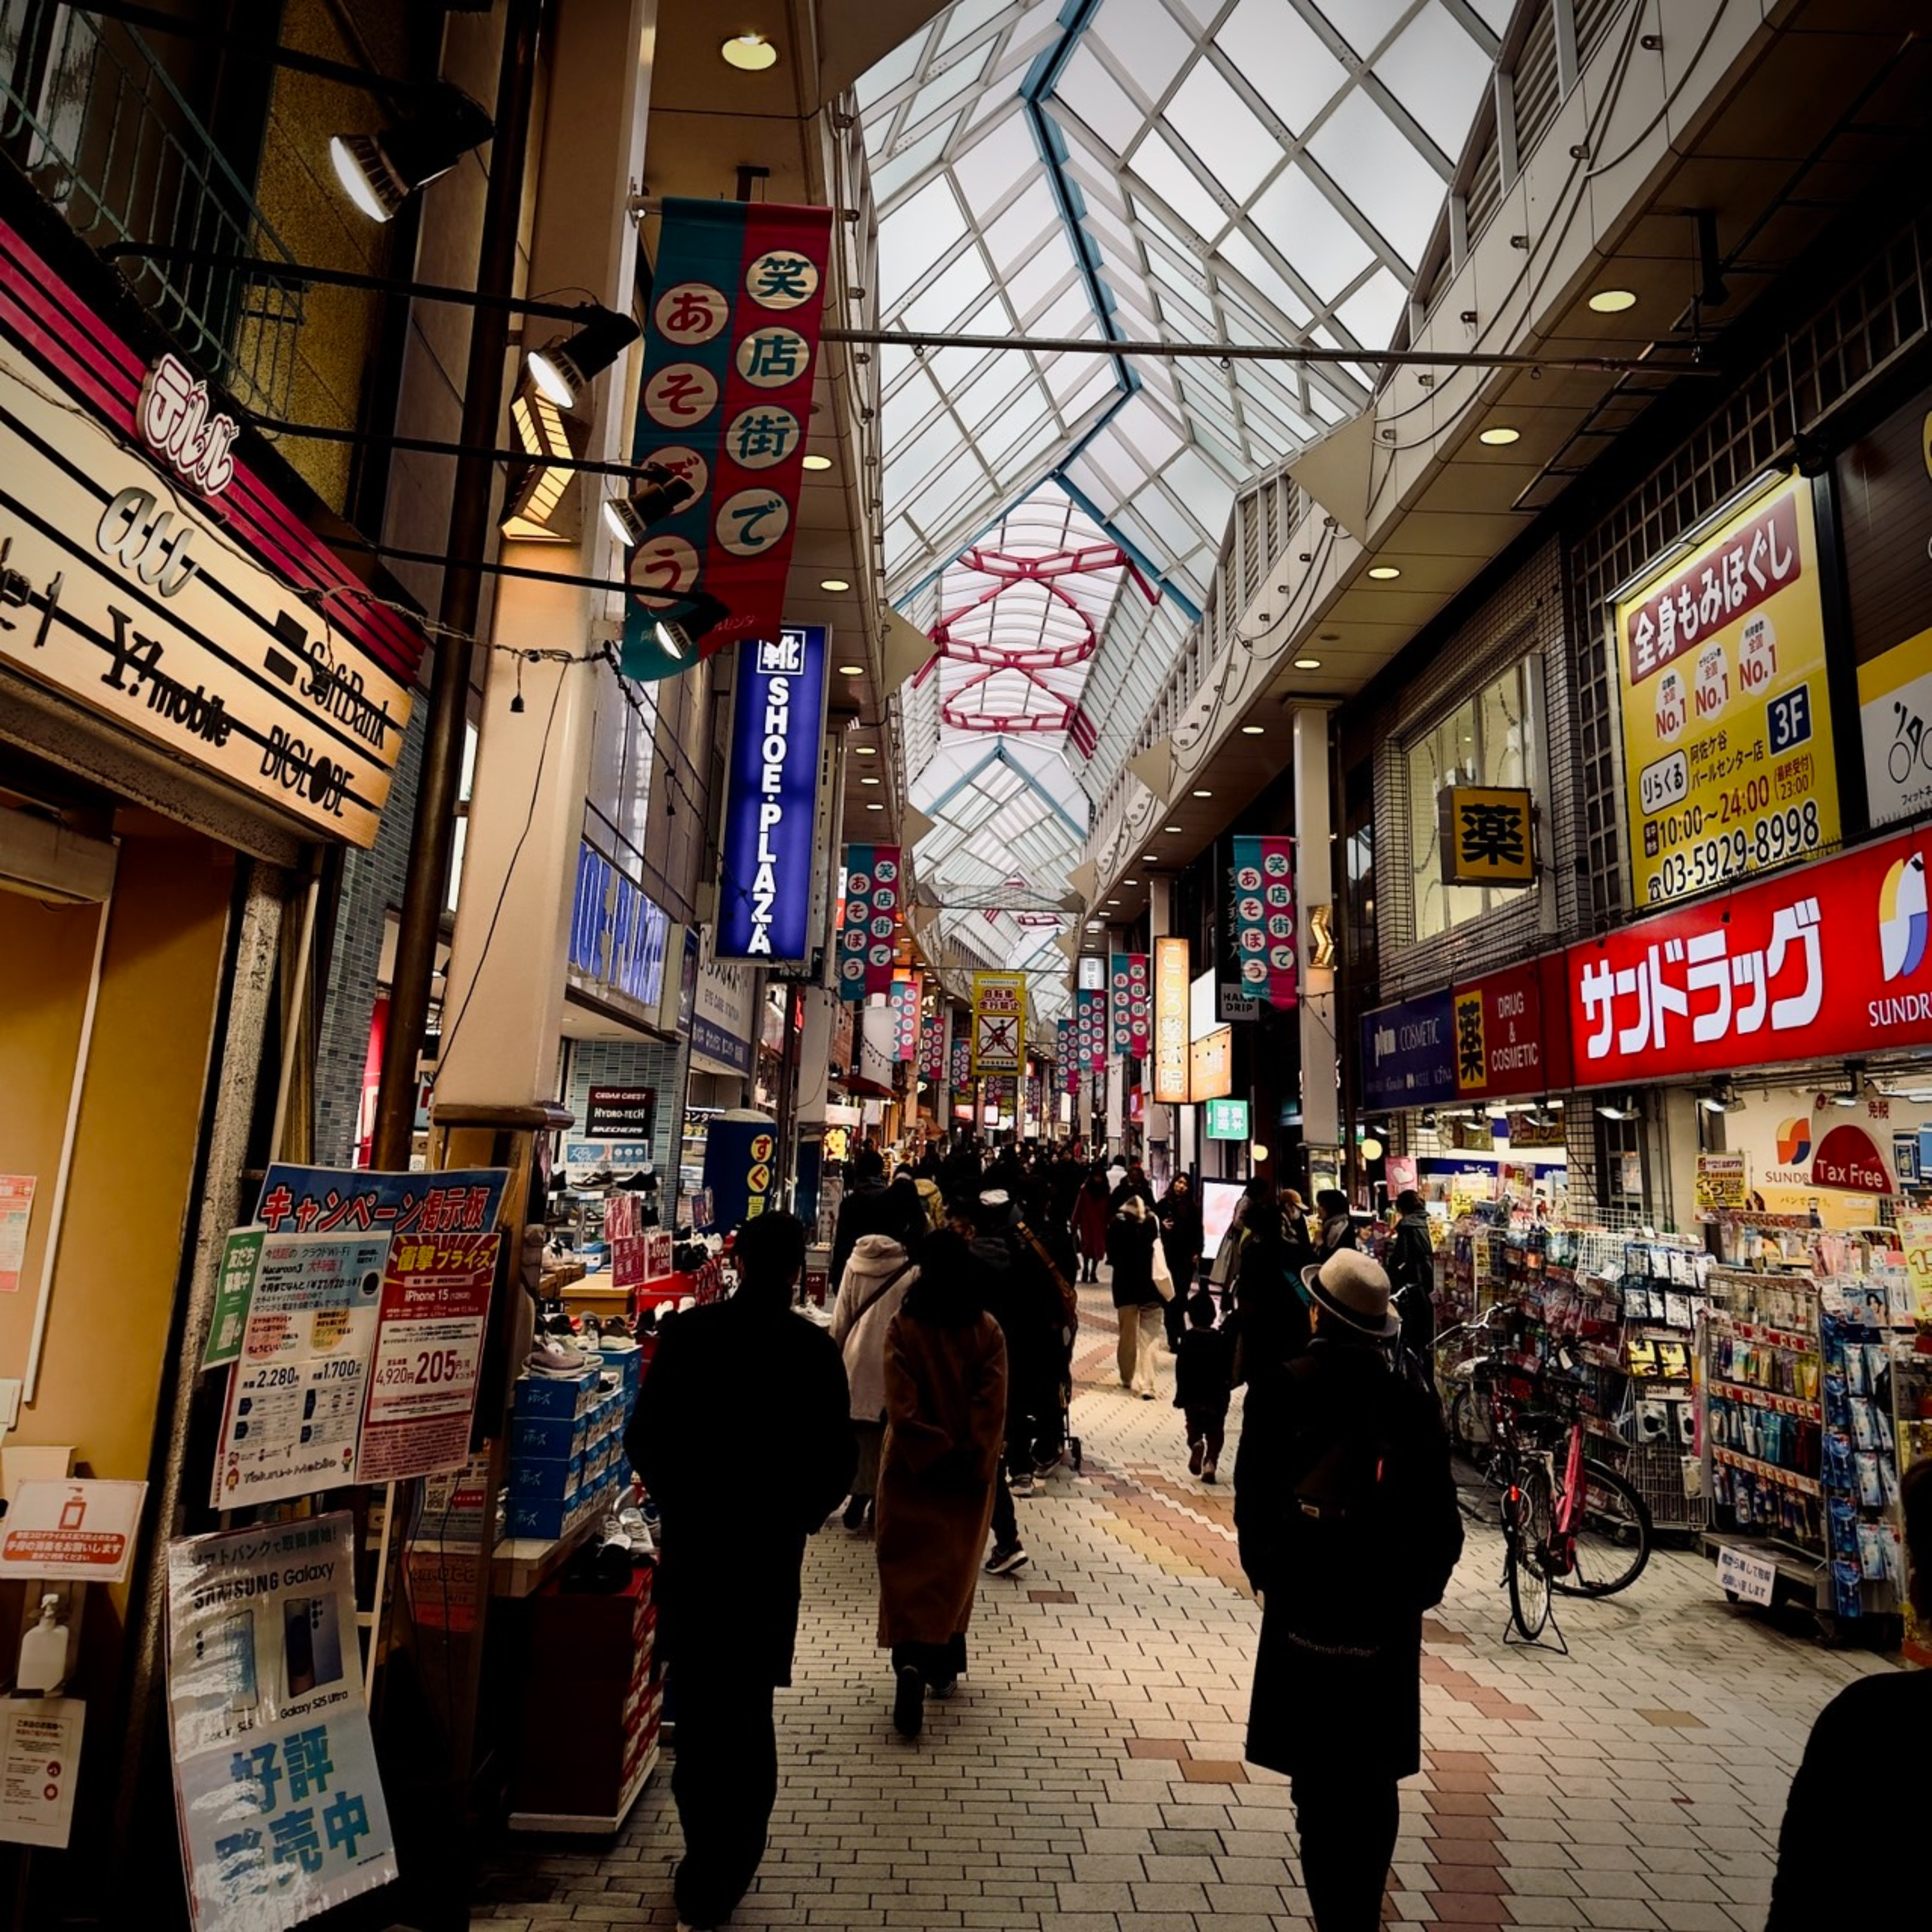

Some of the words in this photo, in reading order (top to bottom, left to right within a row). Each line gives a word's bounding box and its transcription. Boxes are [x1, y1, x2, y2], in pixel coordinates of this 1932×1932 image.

[97, 486, 200, 598] au
[1632, 518, 1794, 672] 全身もみほぐし
[1738, 644, 1777, 691] No.1
[299, 639, 389, 750] SoftBank
[1694, 673, 1730, 716] No.1
[1655, 697, 1687, 738] No.1
[1775, 693, 1803, 744] 3F
[260, 724, 355, 816] BIGLOBE
[1643, 764, 1683, 804] りらくる
[1460, 802, 1524, 865] 薬
[1662, 800, 1821, 899] 03-5929-8998
[873, 864, 894, 965] 笑店街で
[1269, 857, 1291, 967] 笑店街で
[1580, 897, 1823, 1060] サンドラッグ
[1226, 1003, 1253, 1012] DRIP
[1497, 991, 1524, 1017] DRUG
[1399, 1016, 1441, 1052] COSMETIC
[1508, 1023, 1516, 1043] &
[1491, 1045, 1539, 1072] COSMETIC
[591, 1126, 644, 1134] SKECHERS
[594, 1107, 645, 1119] HYDRO-TECH
[1868, 1101, 1889, 1119] 免税
[1816, 1159, 1846, 1184] Tax
[1850, 1164, 1884, 1189] Free
[259, 1184, 491, 1233] キャンペーン掲示板
[404, 1290, 435, 1303] iPhone
[437, 1288, 450, 1301] 15
[193, 1571, 279, 1609] SAMSUNG
[283, 1561, 335, 1586] Galaxy
[279, 1702, 312, 1723] Galaxy
[312, 1697, 327, 1711] S25
[328, 1690, 348, 1705] Ultra
[230, 1724, 334, 1815] 好評
